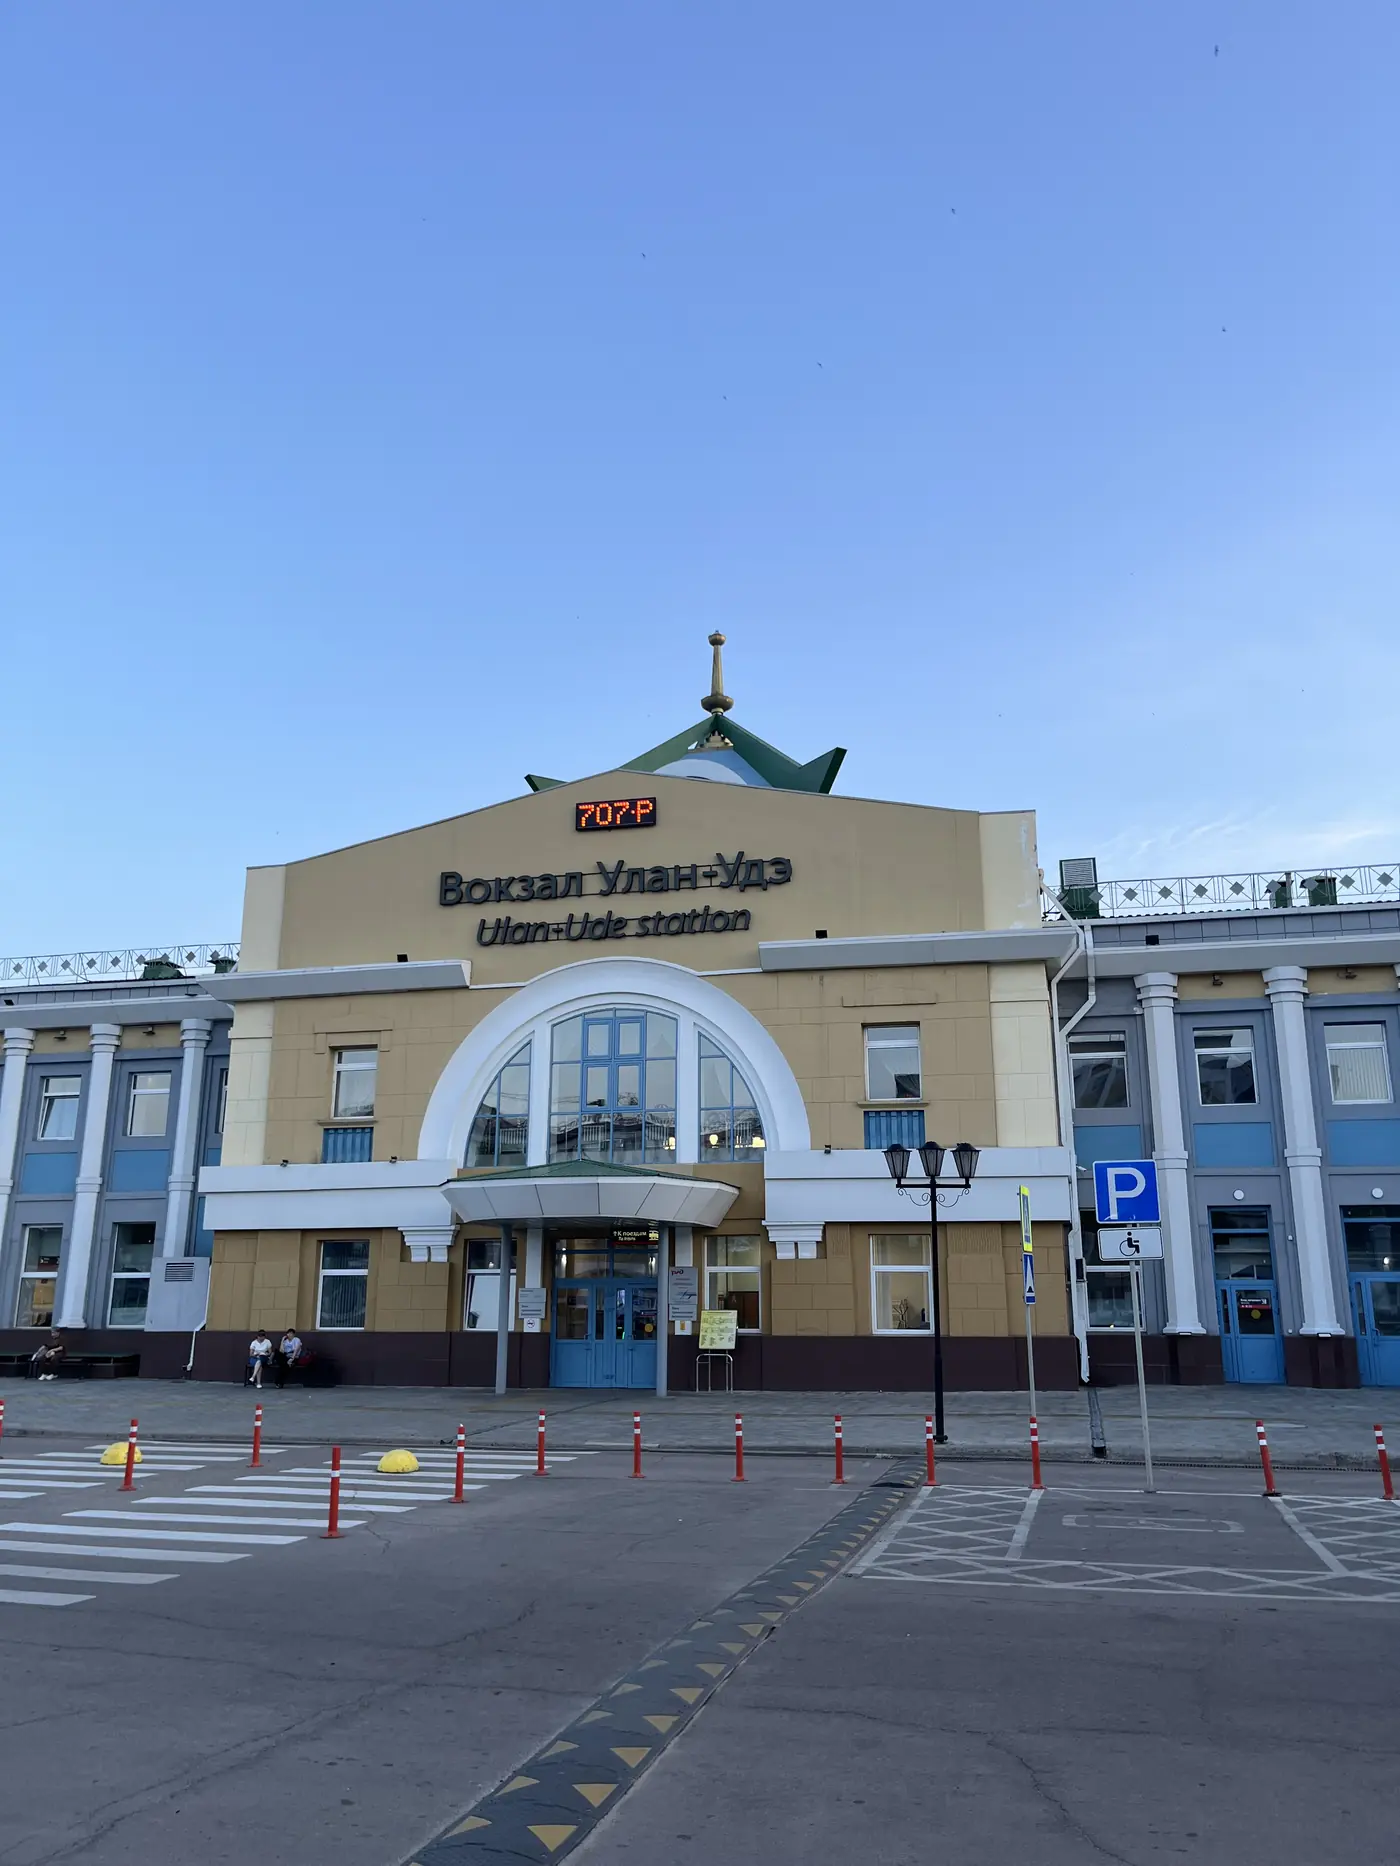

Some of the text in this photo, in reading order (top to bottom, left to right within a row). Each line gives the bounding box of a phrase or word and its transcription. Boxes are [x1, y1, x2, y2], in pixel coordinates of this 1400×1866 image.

[439, 851, 793, 906] Вокзал Улан-Удэ
[477, 905, 751, 946] Ulan-Ude station
[1106, 1167, 1146, 1220] P
